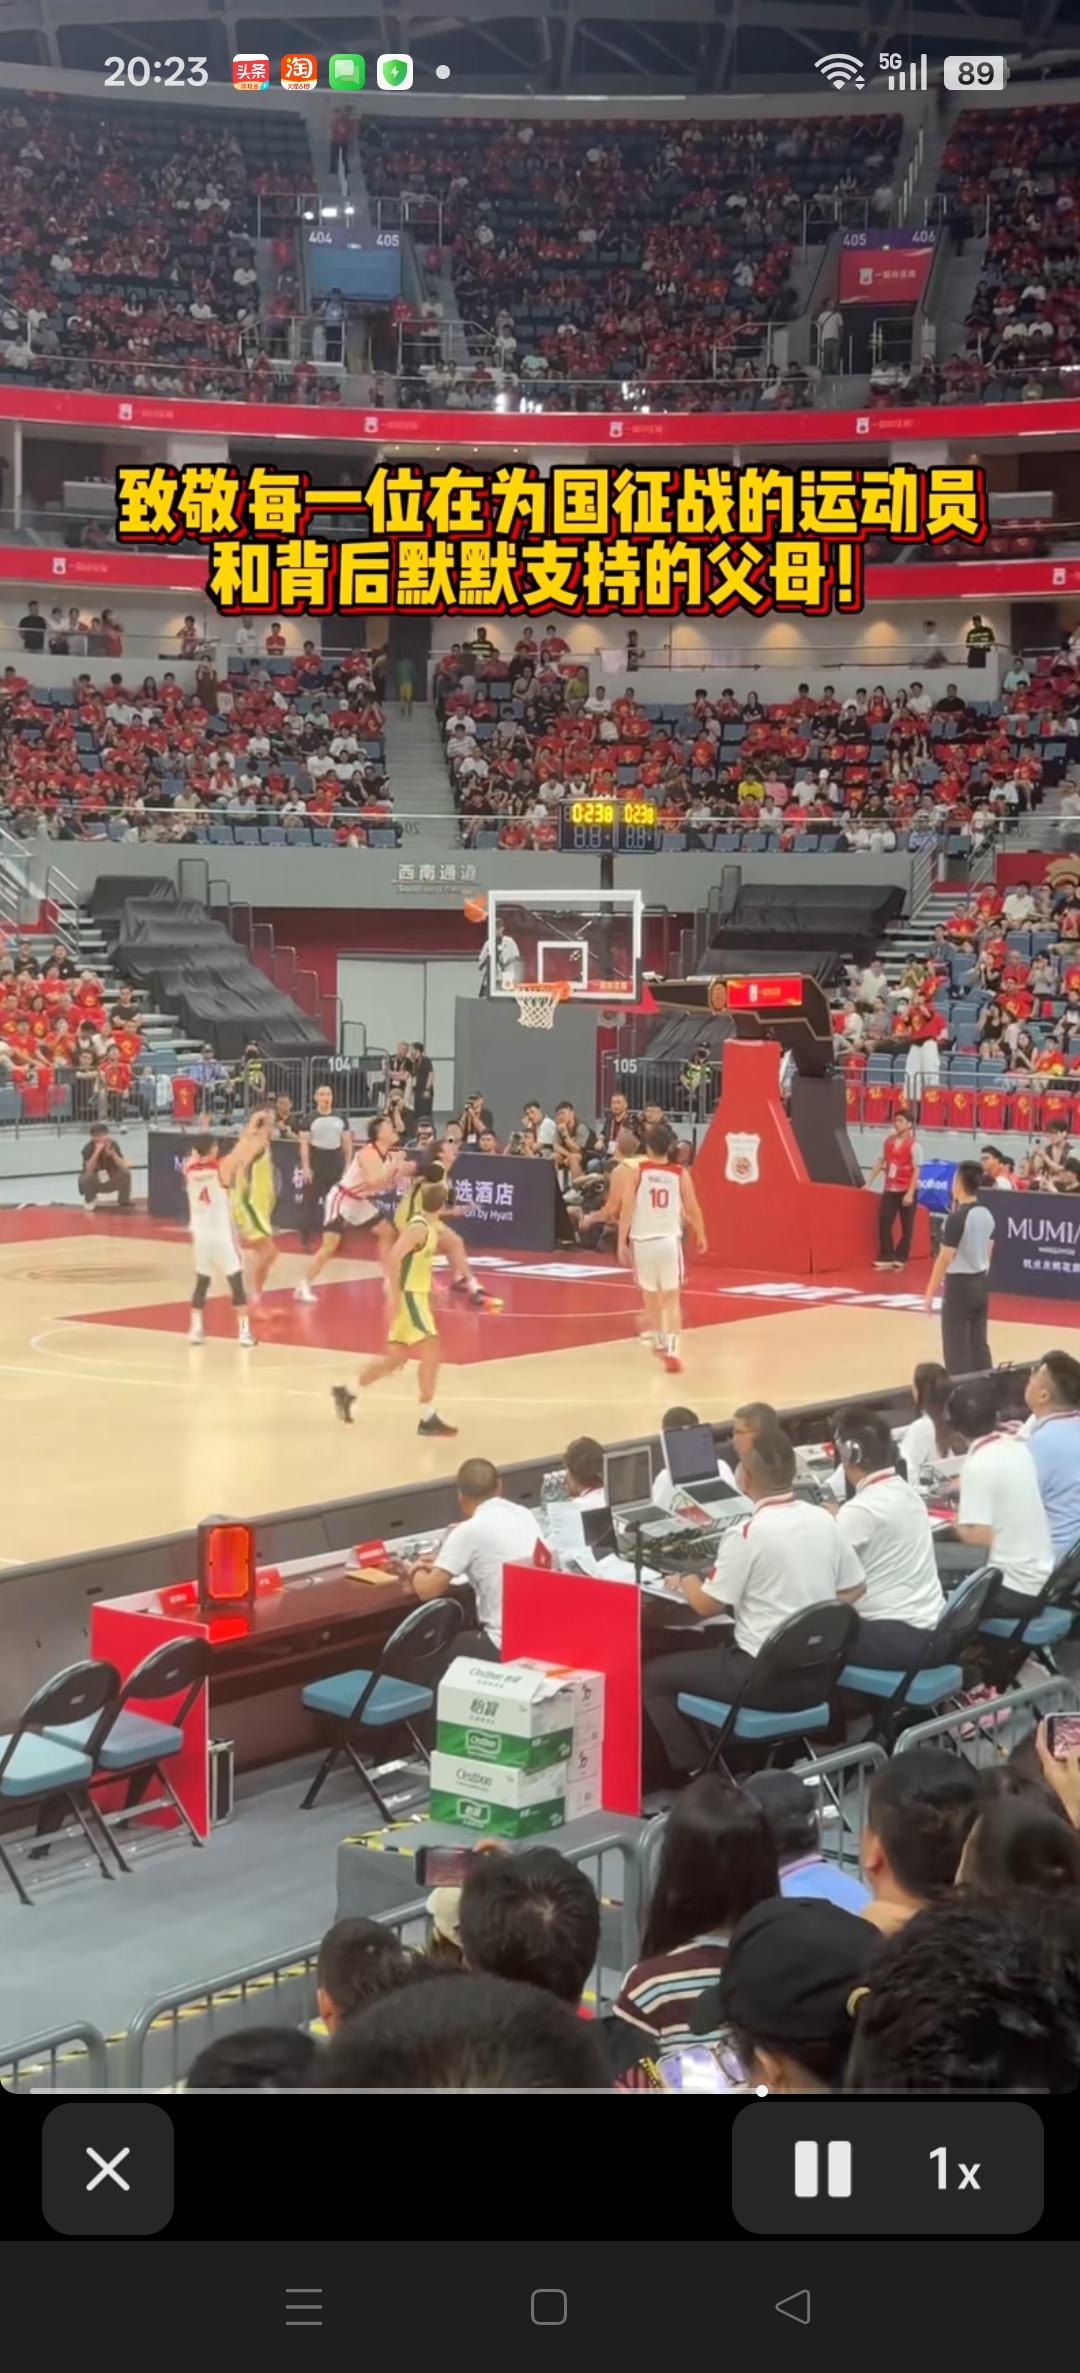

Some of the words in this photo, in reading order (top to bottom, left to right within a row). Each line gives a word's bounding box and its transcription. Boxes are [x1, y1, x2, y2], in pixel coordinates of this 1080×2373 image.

[308, 231, 332, 244] 404
[376, 233, 400, 247] 405
[843, 232, 867, 247] 405
[912, 229, 936, 243] 406
[328, 1056, 351, 1073] 104
[613, 1058, 637, 1074] 105
[198, 1186, 212, 1206] 4
[455, 1179, 514, 1207] 选酒店
[649, 1187, 669, 1209] 10
[489, 1210, 513, 1223] Hyatt
